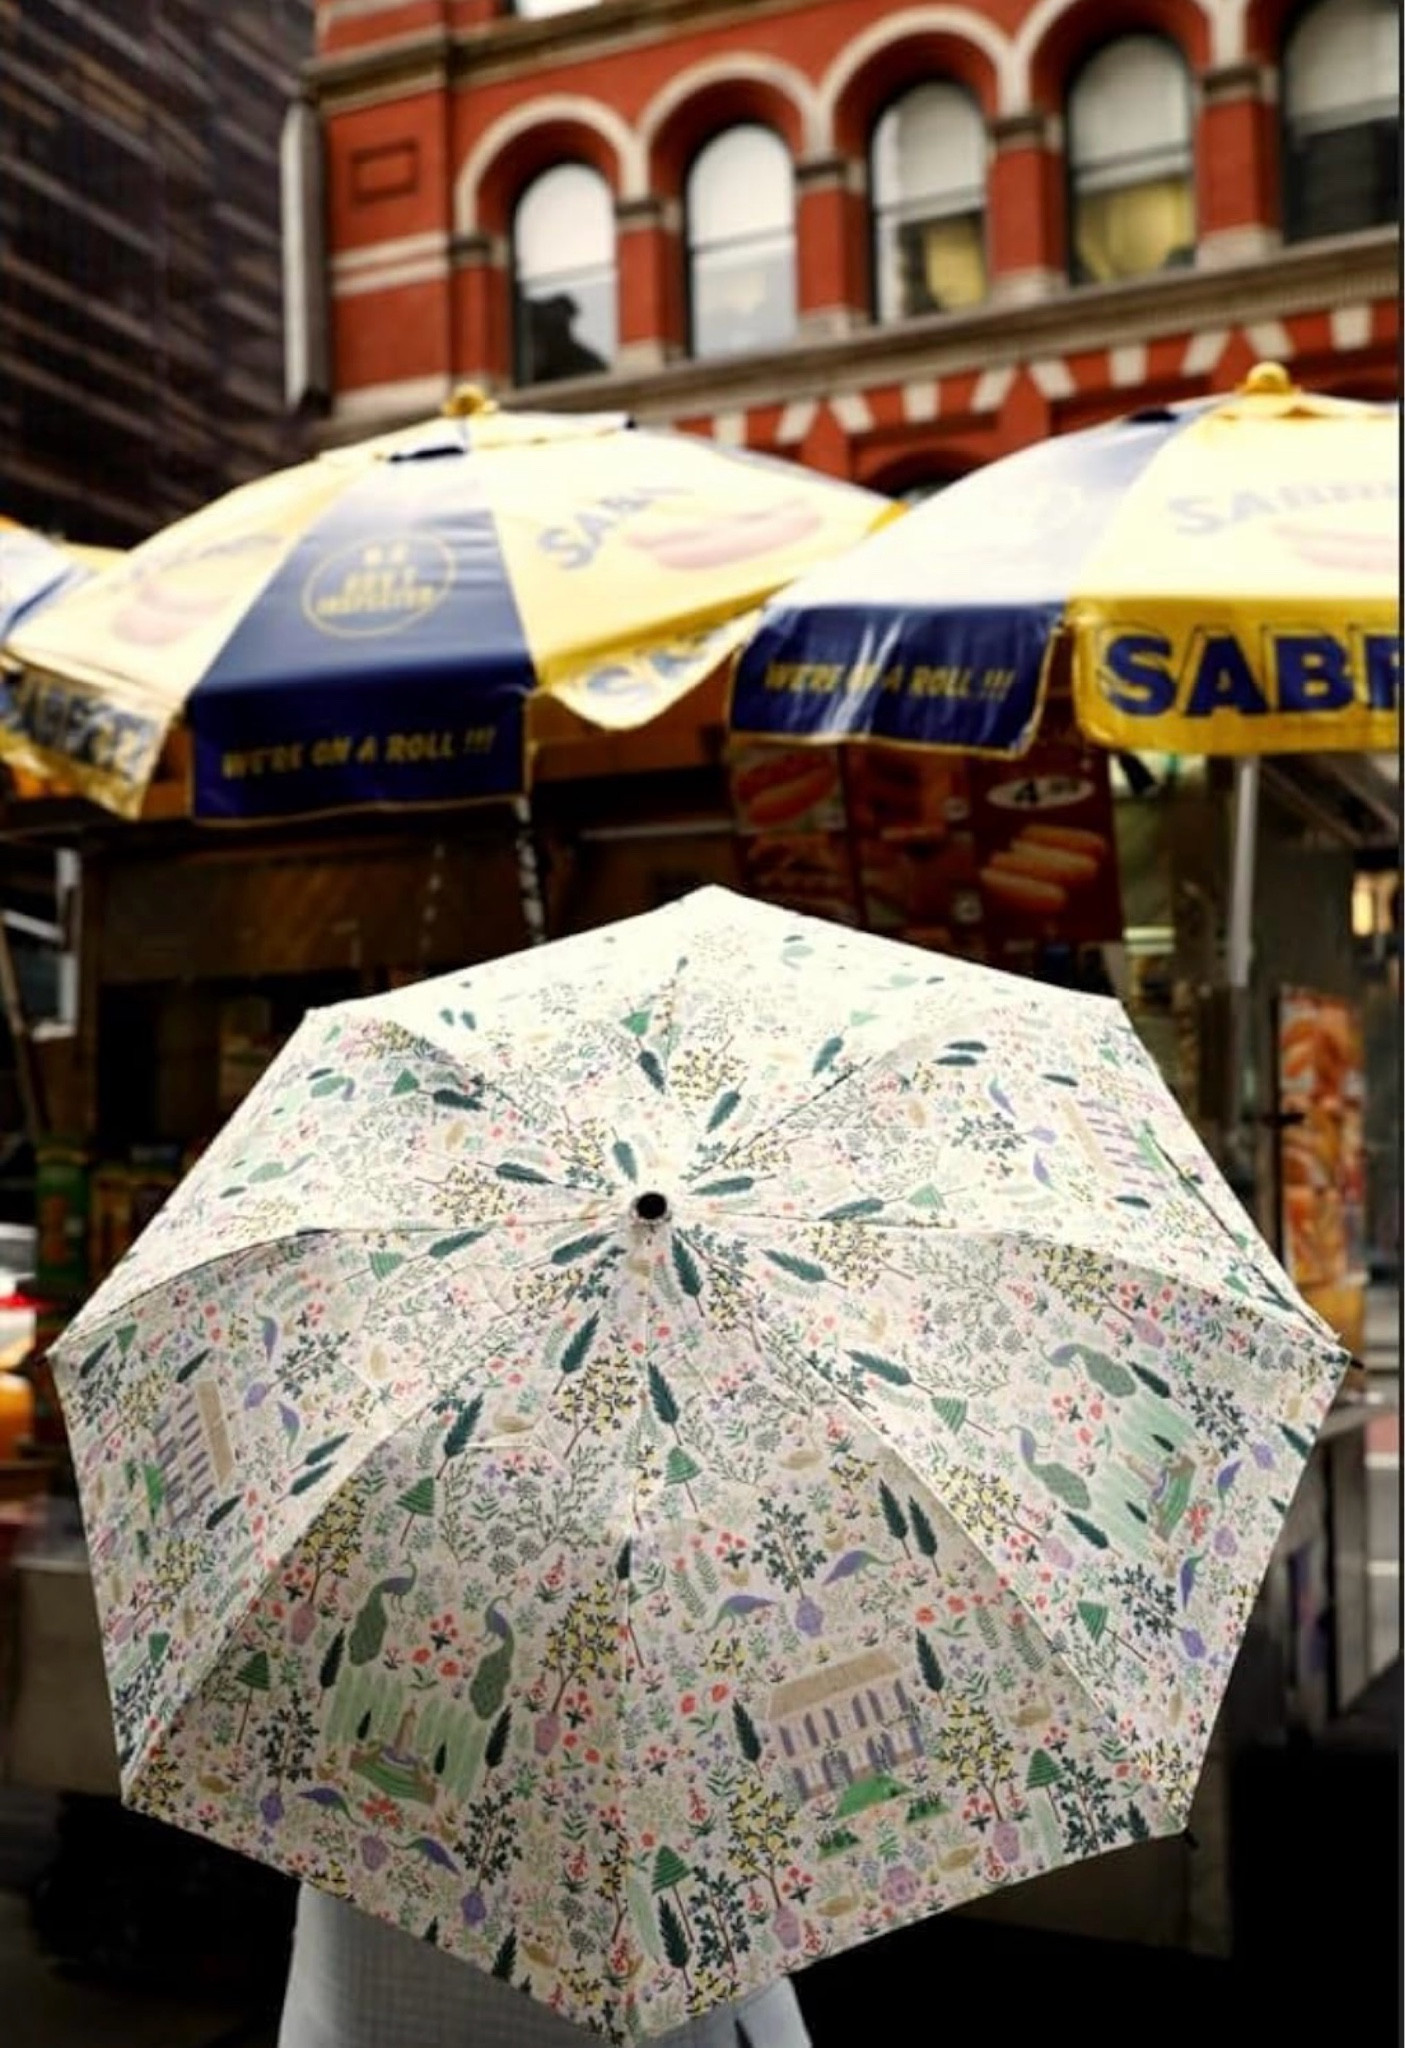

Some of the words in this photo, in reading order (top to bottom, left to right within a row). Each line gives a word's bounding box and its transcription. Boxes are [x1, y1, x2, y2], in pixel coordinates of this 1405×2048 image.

[910, 664, 972, 697] ROLL
[311, 736, 352, 767] ON
[356, 735, 378, 763] A
[385, 730, 454, 763] ROLL
